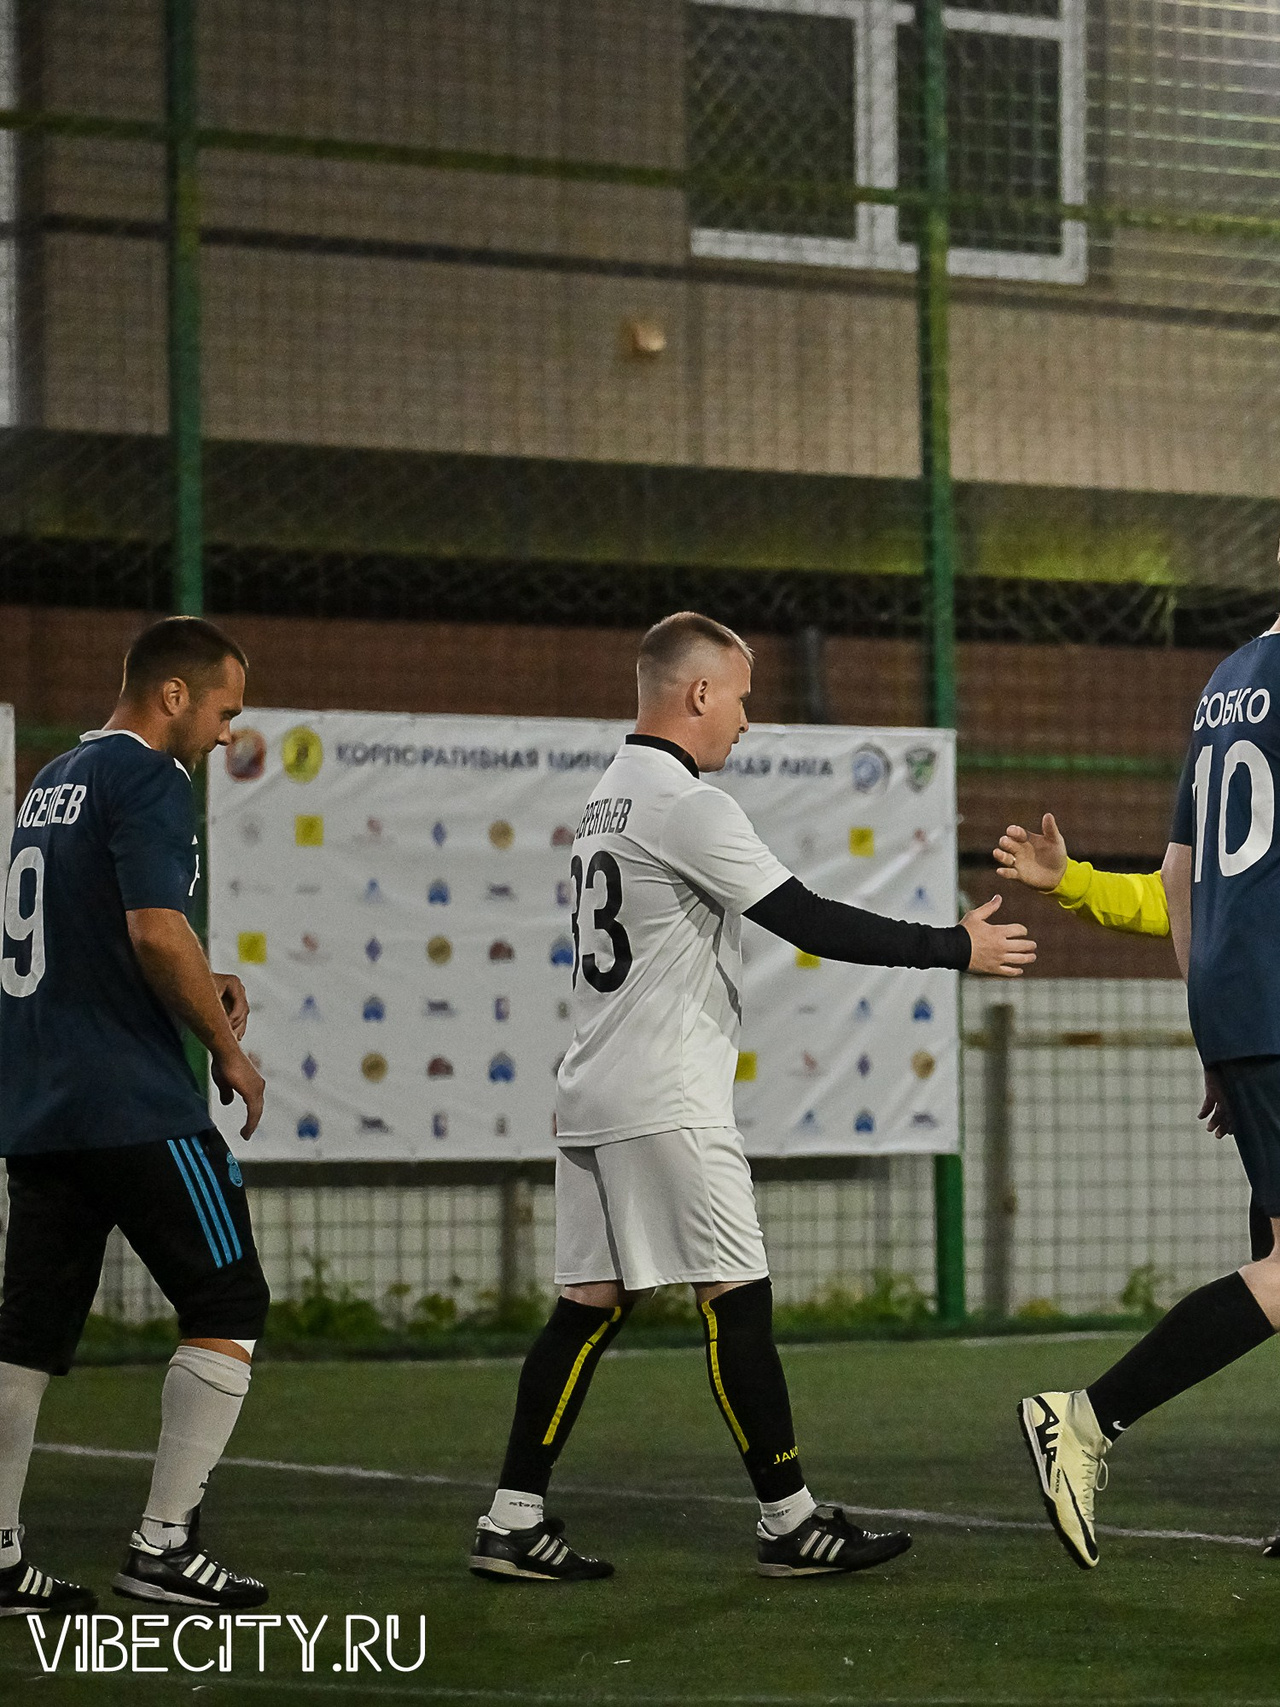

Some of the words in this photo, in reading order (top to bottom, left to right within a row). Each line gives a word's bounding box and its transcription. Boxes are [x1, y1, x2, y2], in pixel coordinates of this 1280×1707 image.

[1193, 688, 1270, 731] СОБКО
[1192, 739, 1275, 883] 10
[2, 846, 46, 998] 9
